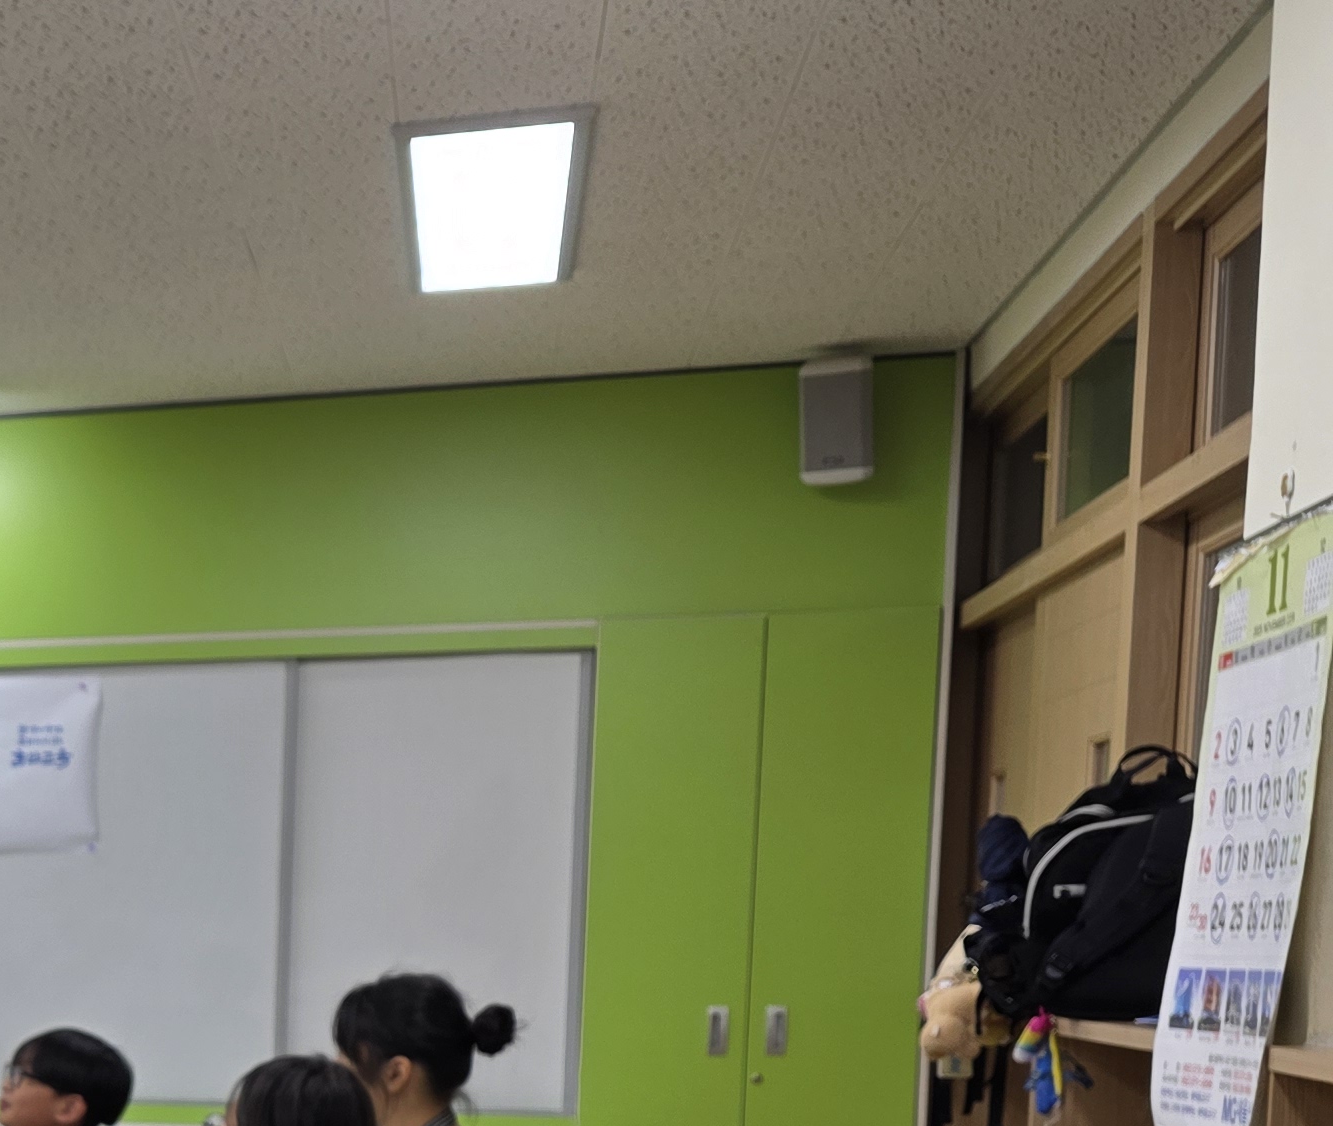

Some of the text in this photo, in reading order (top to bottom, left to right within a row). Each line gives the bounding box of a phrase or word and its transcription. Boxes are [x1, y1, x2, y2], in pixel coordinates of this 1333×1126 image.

[1266, 542, 1290, 616] 11
[1214, 730, 1222, 760] 2
[1230, 726, 1239, 757] 3
[1247, 722, 1254, 752] 4
[1264, 718, 1272, 750] 5
[1293, 709, 1301, 743] 7
[1209, 788, 1217, 817] 9
[1224, 784, 1238, 816] 10
[1241, 782, 1253, 815] 11
[1258, 779, 1272, 811] 12
[1273, 775, 1282, 809] 13
[1297, 769, 1308, 803] 15
[1199, 833, 1302, 875] 16 17 18 19 20 21 22
[1211, 898, 1226, 931] 24
[1230, 901, 1244, 932] 25
[1261, 899, 1273, 932] 27
